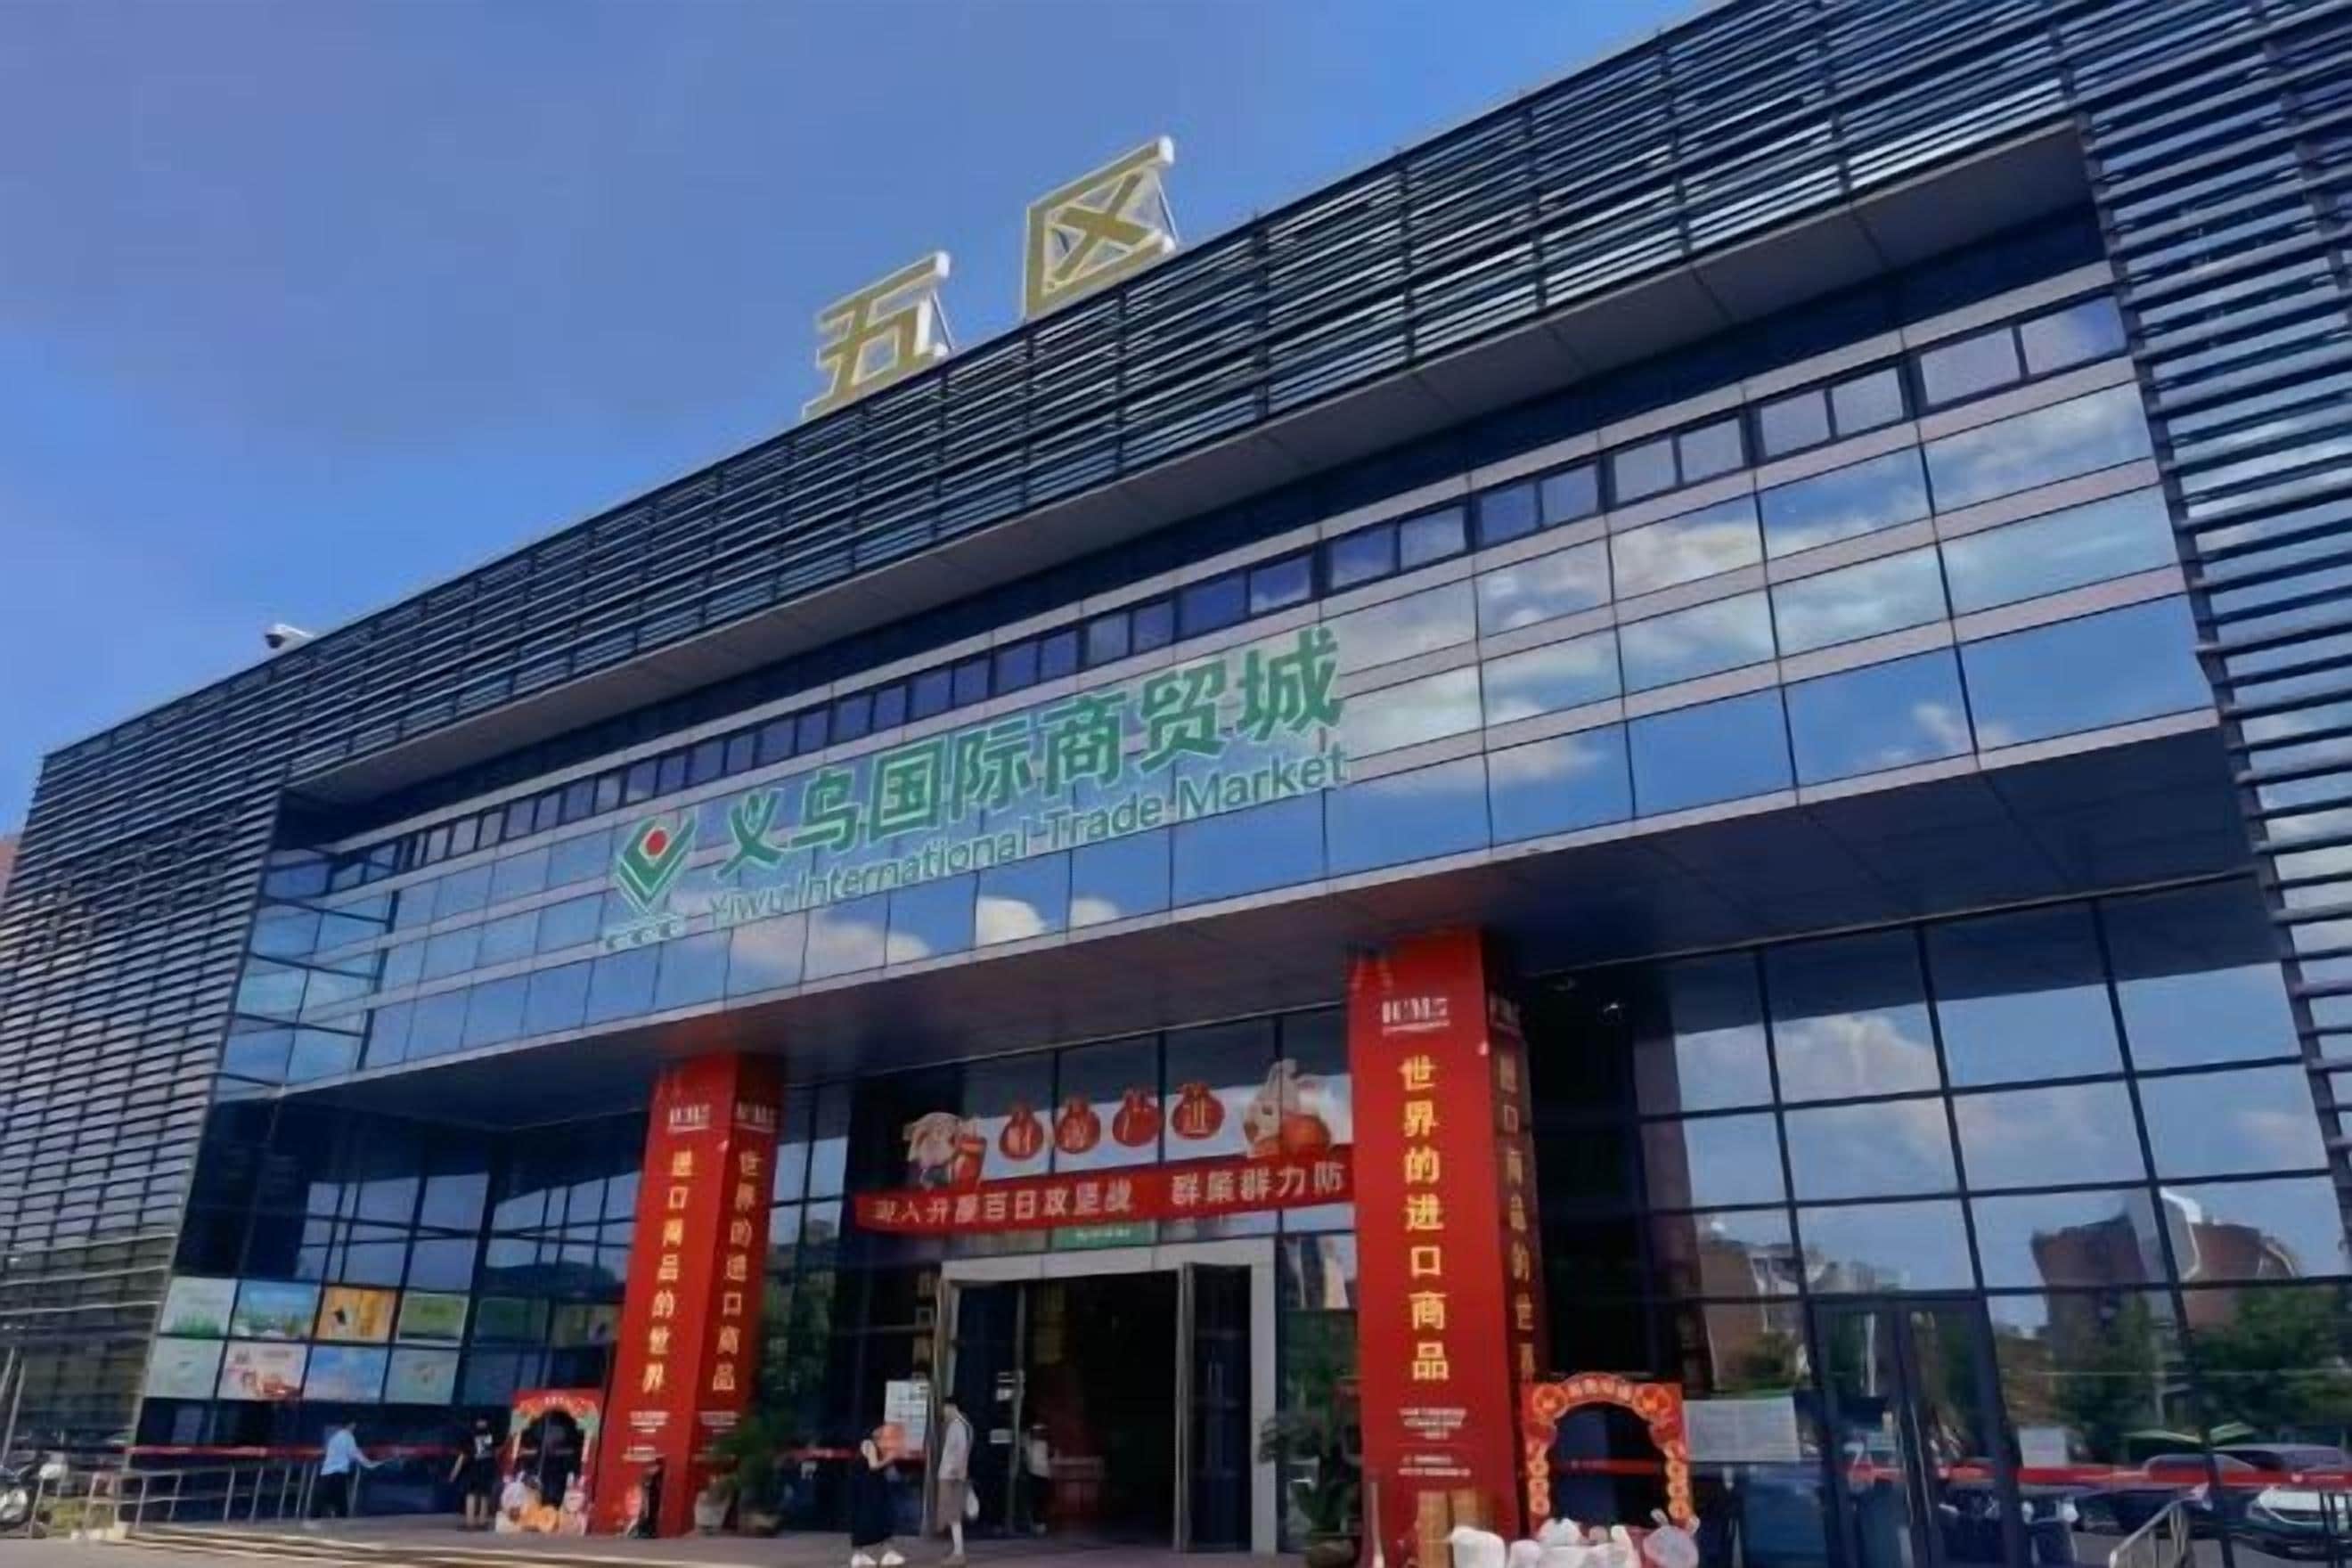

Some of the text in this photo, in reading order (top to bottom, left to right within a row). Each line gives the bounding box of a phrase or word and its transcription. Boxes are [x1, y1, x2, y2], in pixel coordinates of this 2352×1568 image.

[802, 135, 1176, 422] 五区
[715, 626, 1344, 878] 义乌国际商贸城
[799, 814, 1029, 904] International
[1042, 791, 1164, 848] Trade
[1175, 740, 1348, 825] Market
[1398, 1055, 1450, 1381] 世界的进口商品
